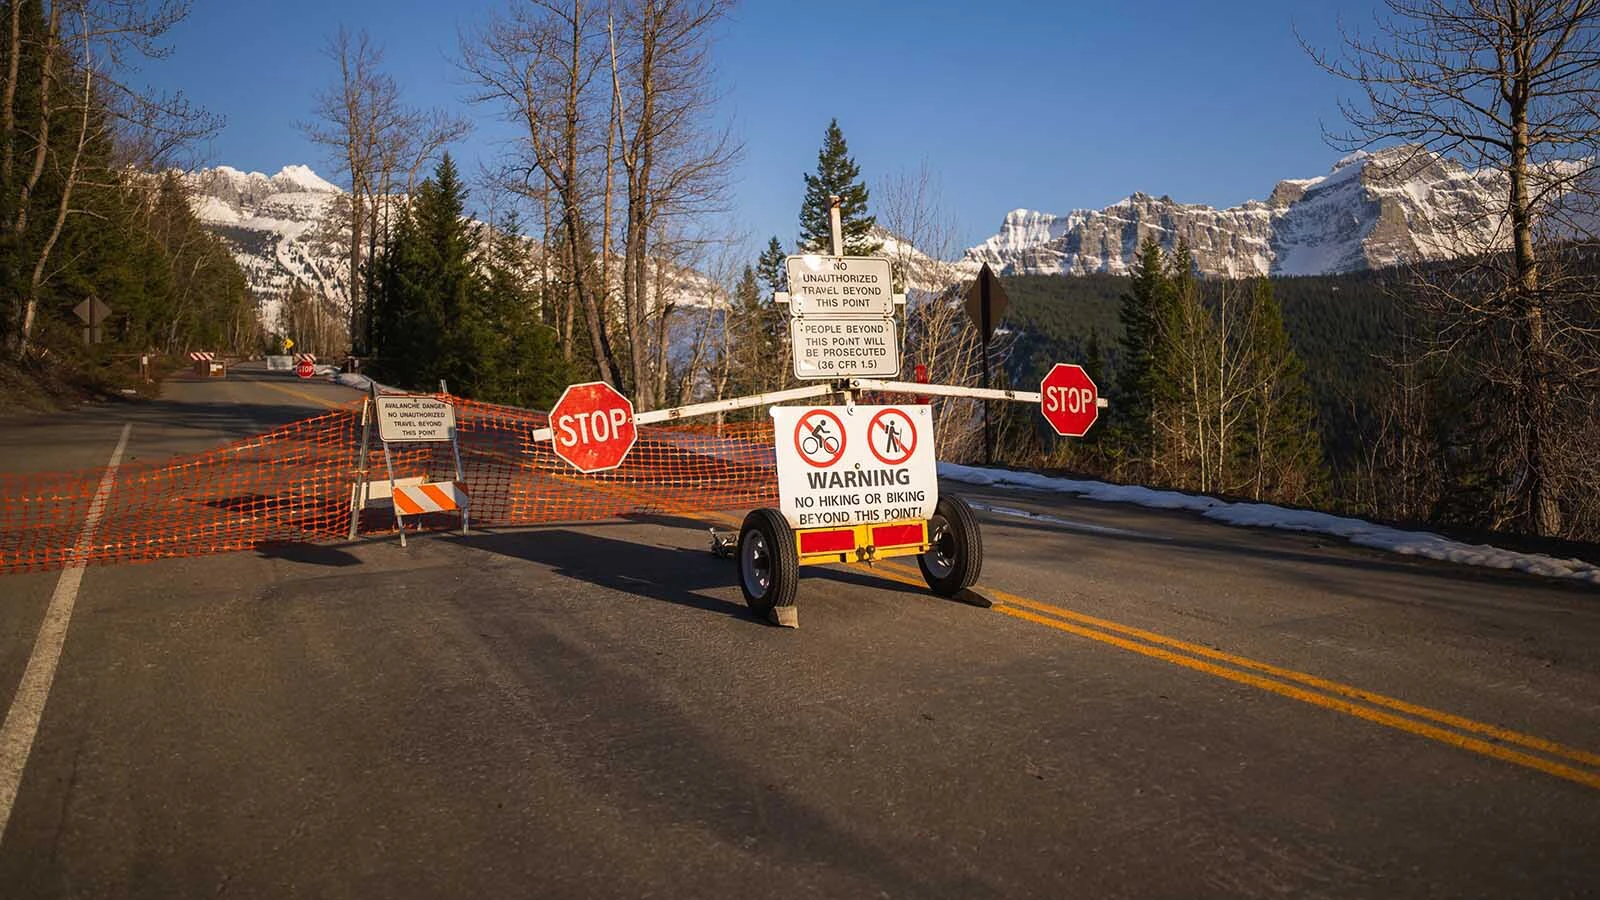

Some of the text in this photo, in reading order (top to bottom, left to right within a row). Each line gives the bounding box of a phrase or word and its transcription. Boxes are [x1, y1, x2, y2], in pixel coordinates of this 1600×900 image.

[833, 262, 848, 271] NO
[803, 274, 878, 283] UNAUTHORIZED
[802, 286, 881, 295] TRAVEL BEYOND
[816, 298, 870, 308] THIS POINT
[805, 325, 884, 334] PEOPLE BEYOND
[806, 337, 885, 346] THIS POINT WILL
[806, 348, 886, 357] BE PROSECUTED
[817, 360, 877, 370] (36 CFR 1.5)
[1046, 385, 1093, 414] STOP
[558, 408, 627, 447] STOP
[807, 468, 910, 489] WARNING
[795, 490, 925, 508] NO HIKING OR BIKING
[799, 507, 922, 525] BEYOND THIS POINT!
